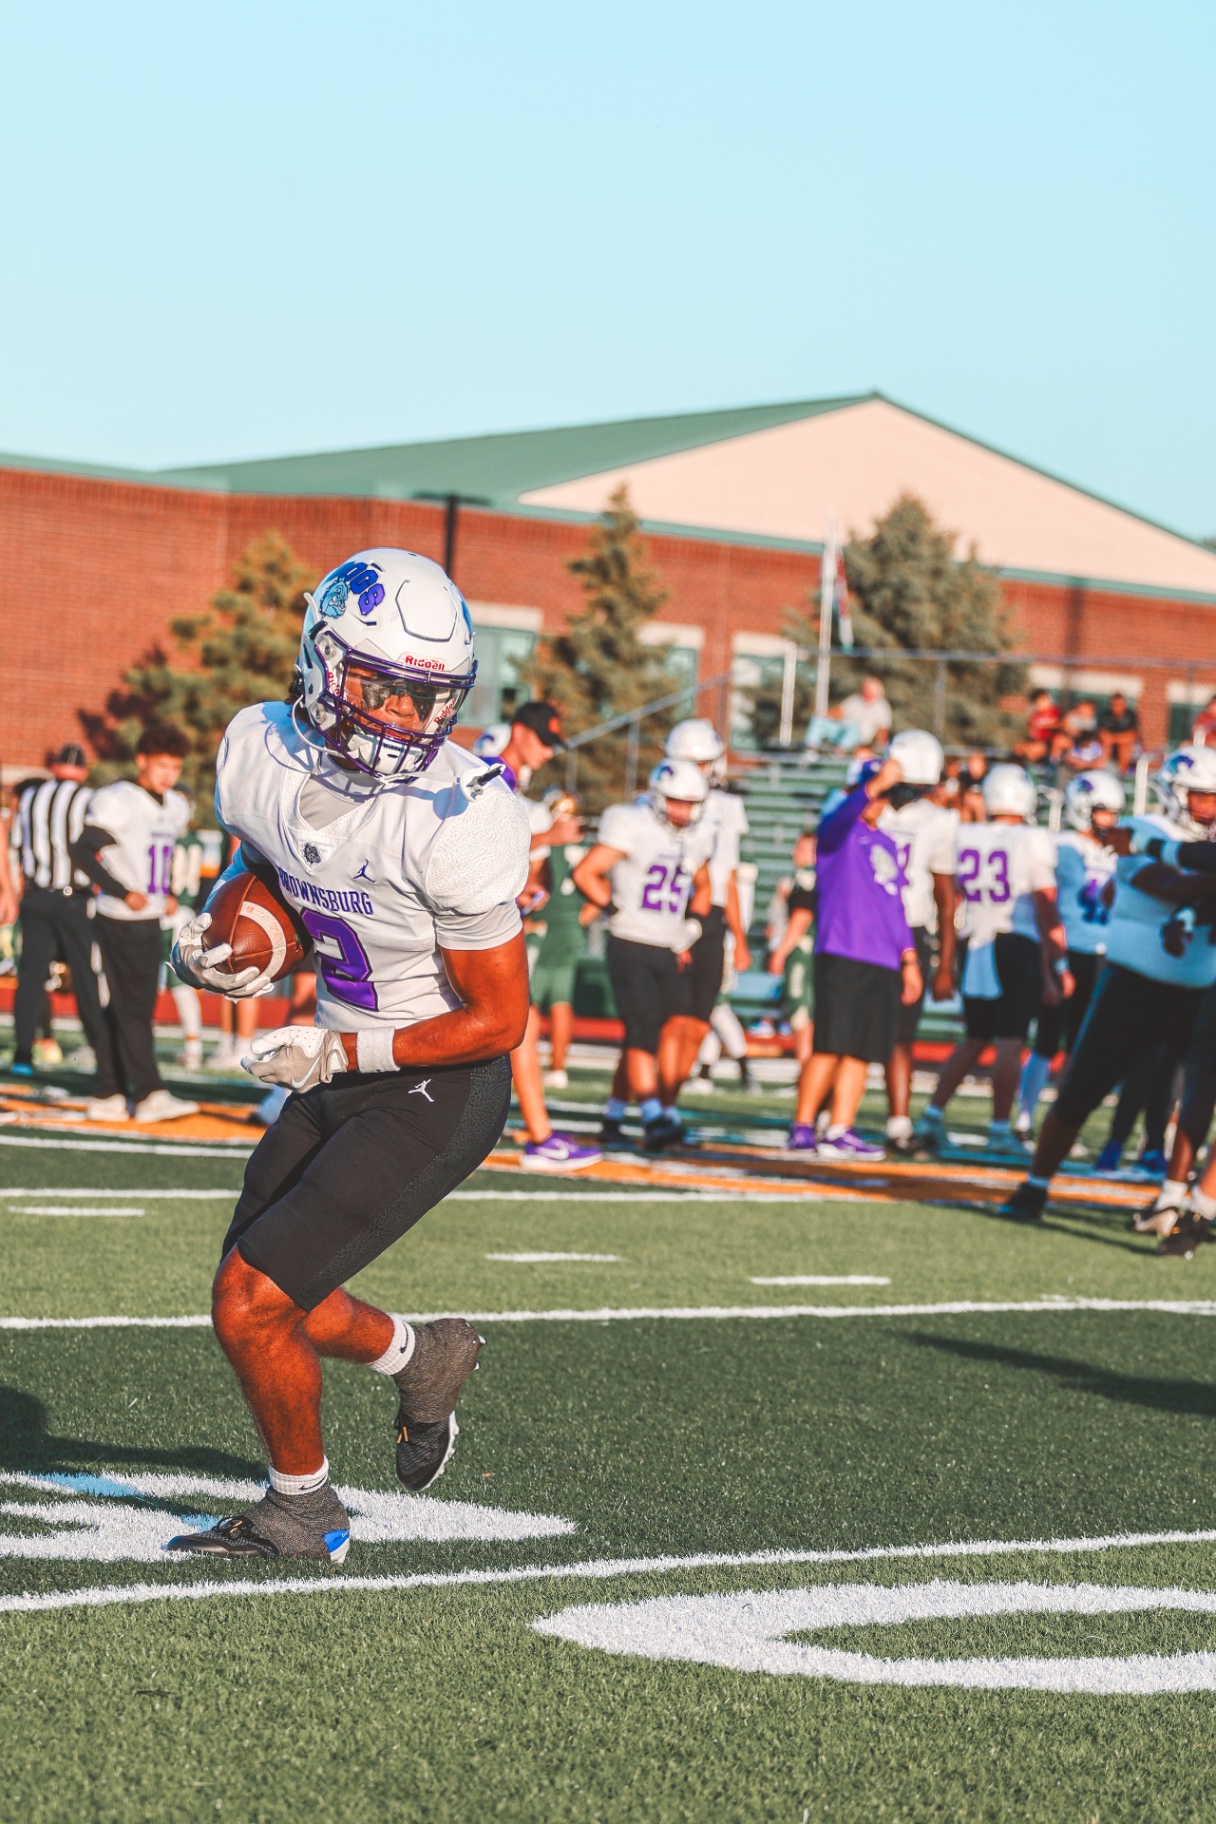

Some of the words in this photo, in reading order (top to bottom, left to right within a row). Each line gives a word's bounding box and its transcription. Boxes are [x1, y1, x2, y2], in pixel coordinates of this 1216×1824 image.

[642, 864, 688, 913] 25
[959, 848, 1011, 903] 23
[300, 906, 379, 1012] 2
